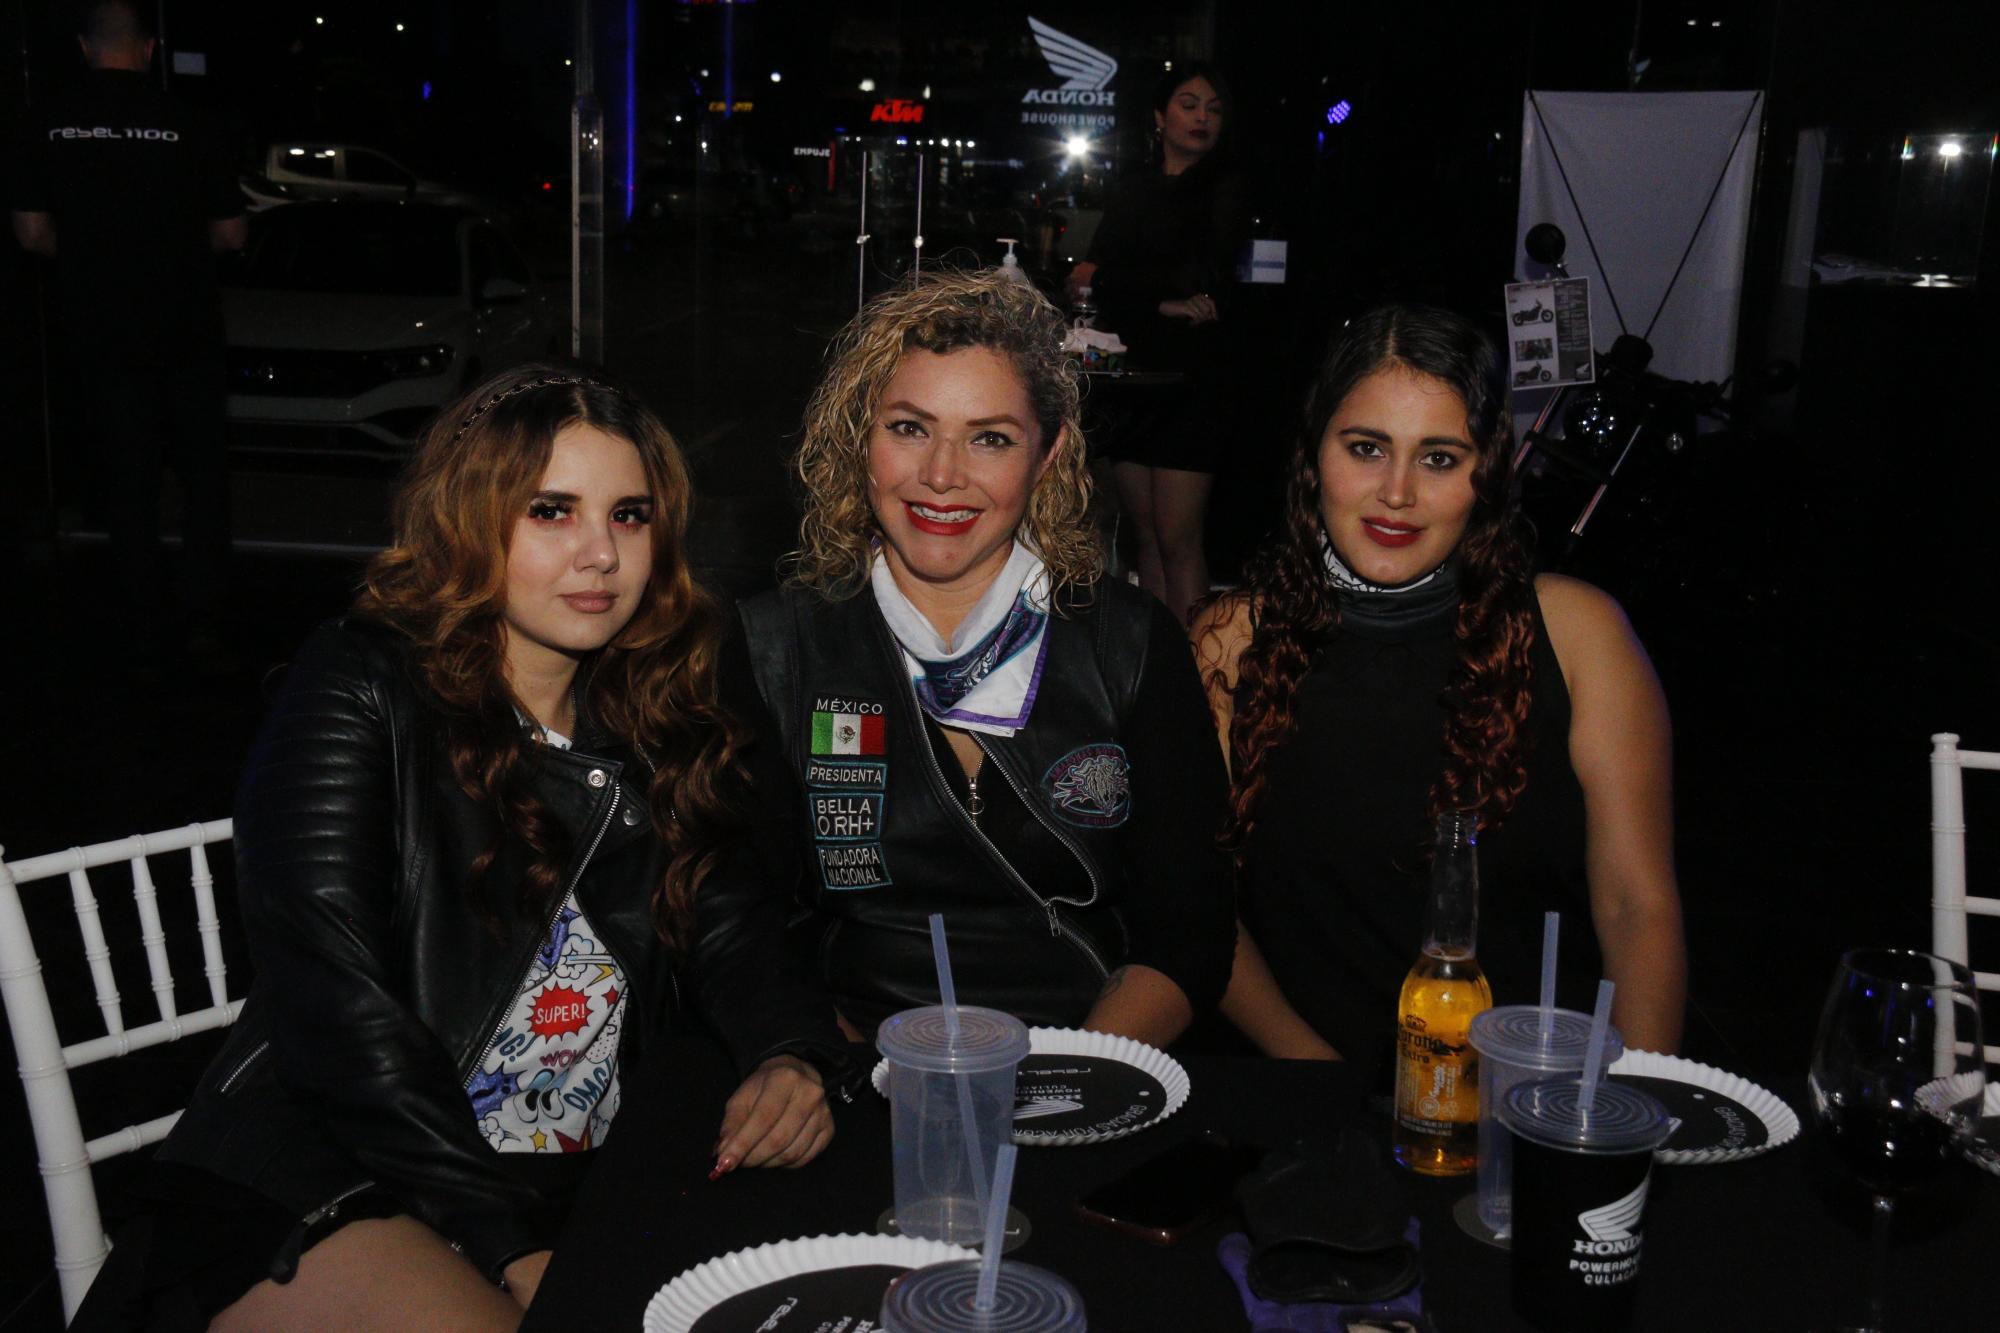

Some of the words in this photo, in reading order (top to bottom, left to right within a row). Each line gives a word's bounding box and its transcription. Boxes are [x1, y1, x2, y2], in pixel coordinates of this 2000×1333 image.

[871, 99, 924, 122] KTM
[793, 147, 830, 157] EMPUJE
[816, 697, 883, 715] MÉXICO
[809, 766, 883, 784] PRESIDENTA
[817, 798, 872, 815] BELLA
[820, 847, 880, 866] FUNDADORA
[827, 867, 881, 885] NACIONAL
[534, 1003, 586, 1024] SUPER!
